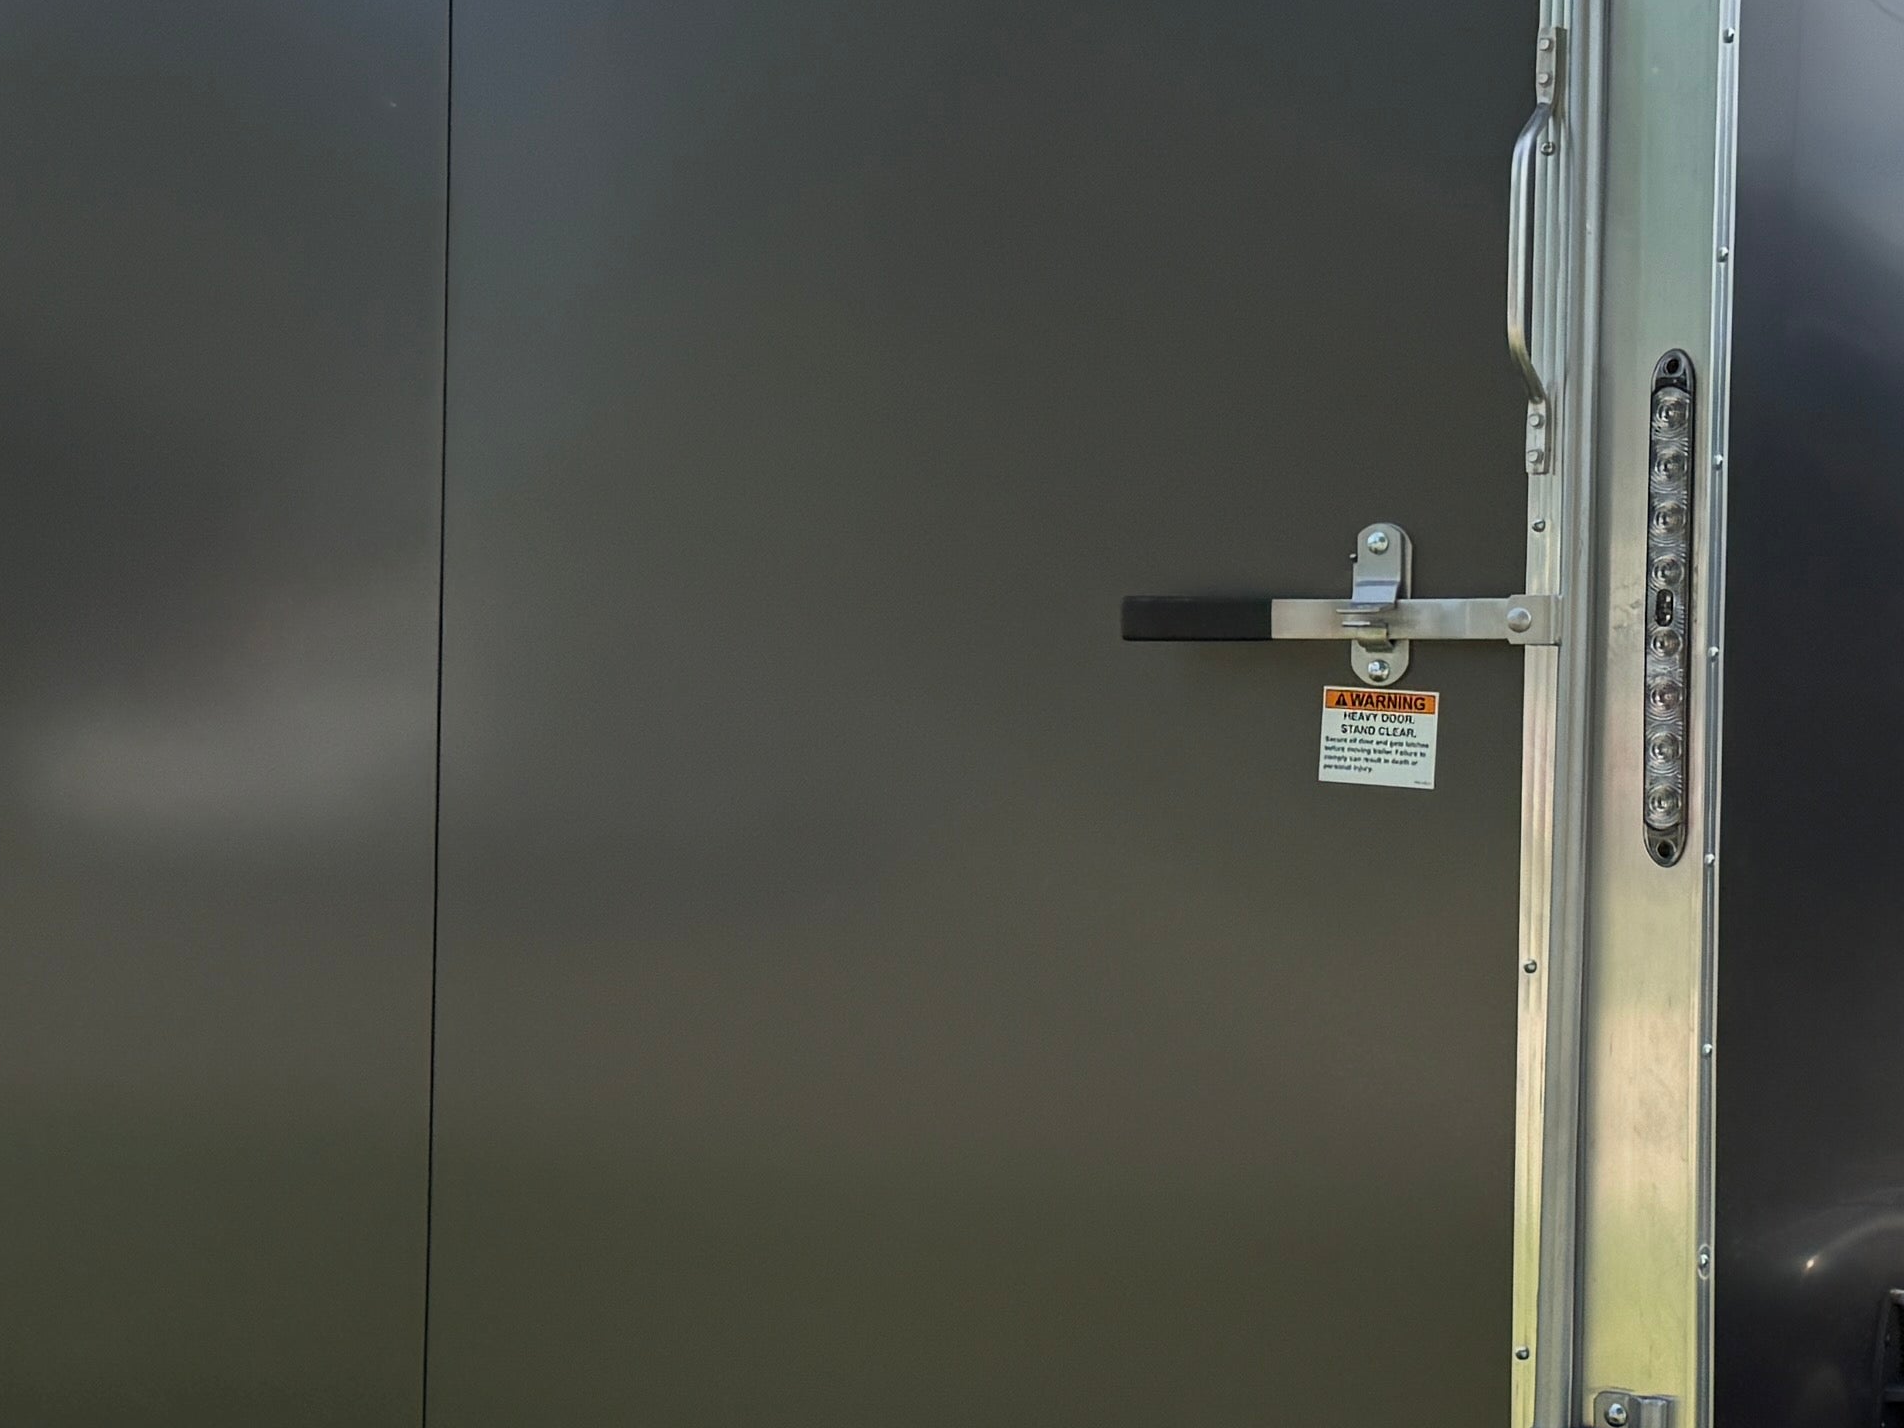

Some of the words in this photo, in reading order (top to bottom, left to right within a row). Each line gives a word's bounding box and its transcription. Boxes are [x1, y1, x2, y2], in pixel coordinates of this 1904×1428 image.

[1350, 693, 1425, 711] WARNING
[1344, 711, 1378, 722] HEAVY
[1341, 724, 1376, 735] STAND
